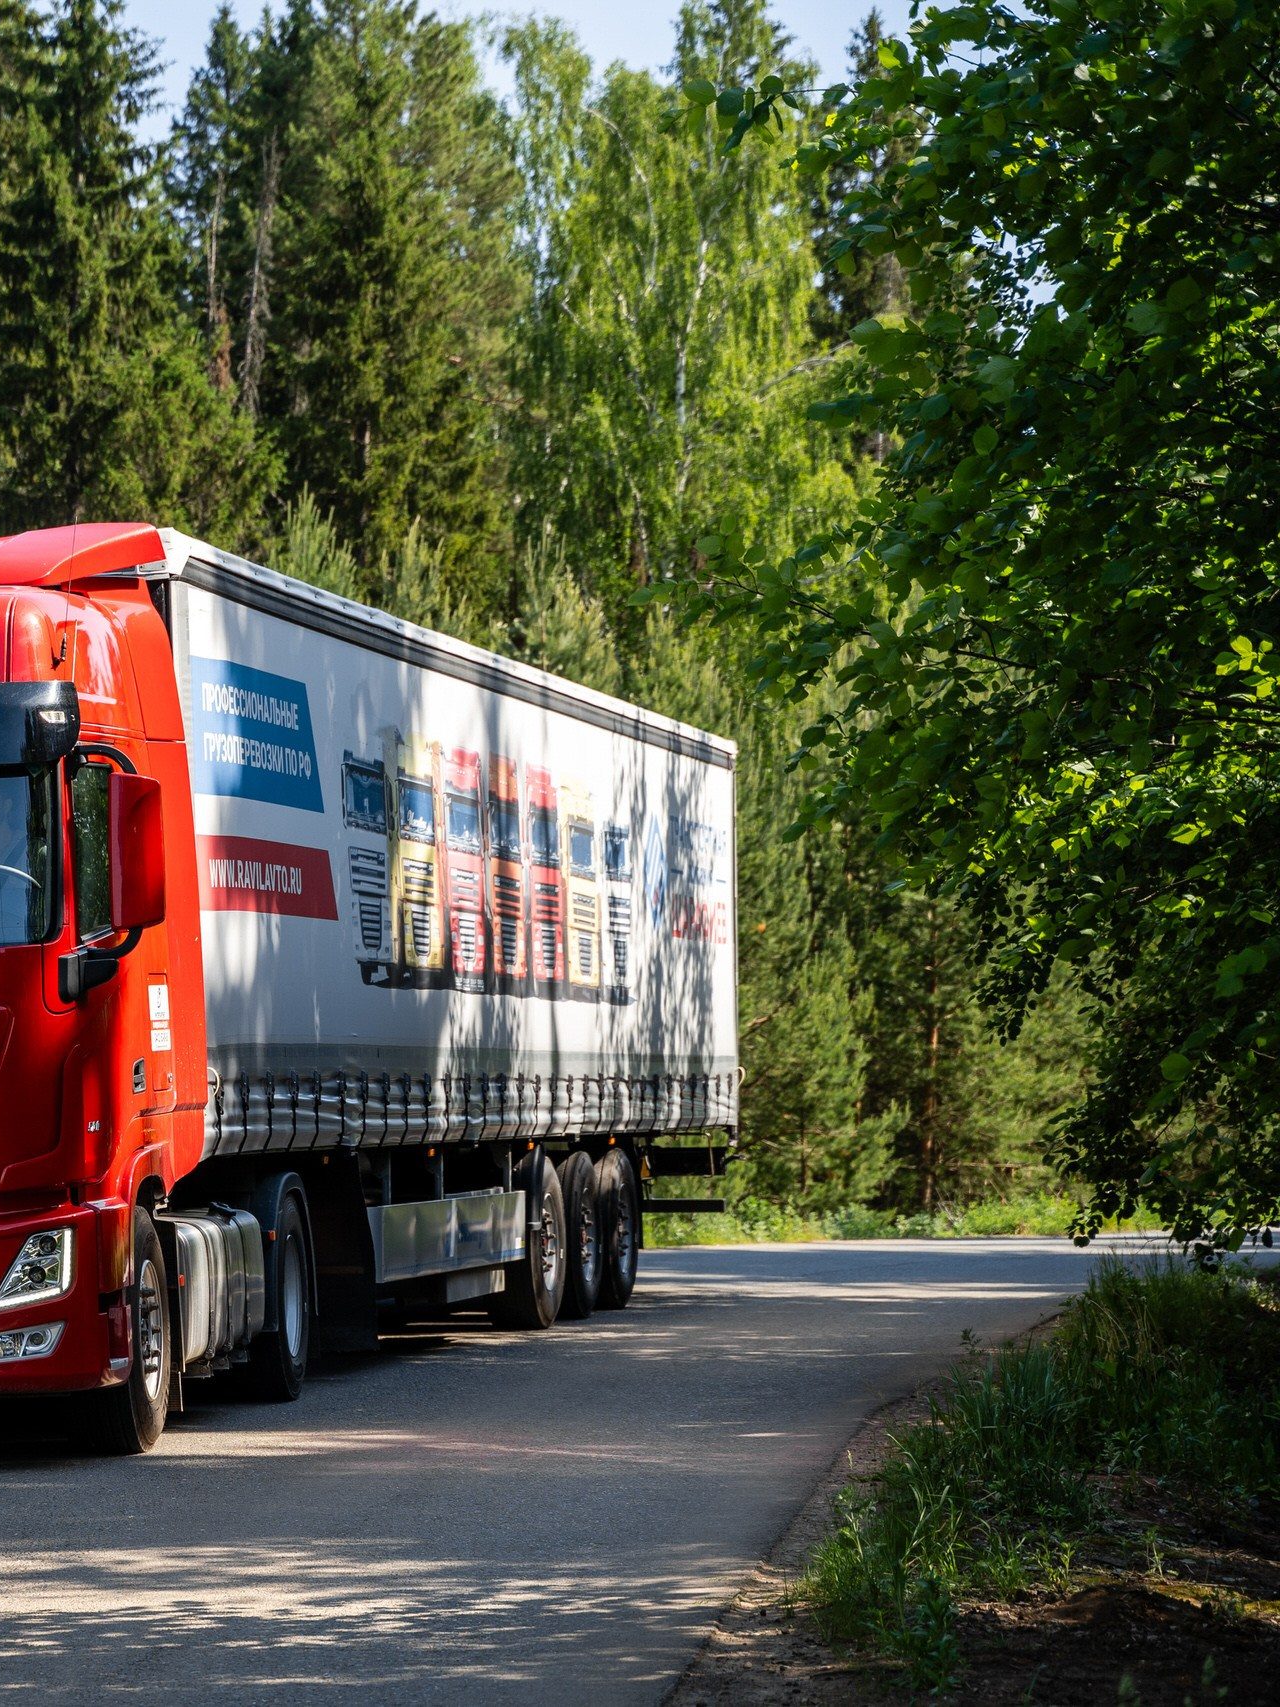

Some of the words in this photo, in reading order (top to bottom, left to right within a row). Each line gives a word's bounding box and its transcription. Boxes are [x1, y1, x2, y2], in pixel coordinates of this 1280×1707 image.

[201, 681, 299, 731] ПРОФЕССИОНАЛЬНЫЕ
[203, 731, 284, 774] ГРУЗОПЕРЕВОЗКИ
[285, 745, 298, 777] ПО
[299, 747, 311, 780] РФ
[209, 858, 303, 895] WWW.RAVILAVTO.RU
